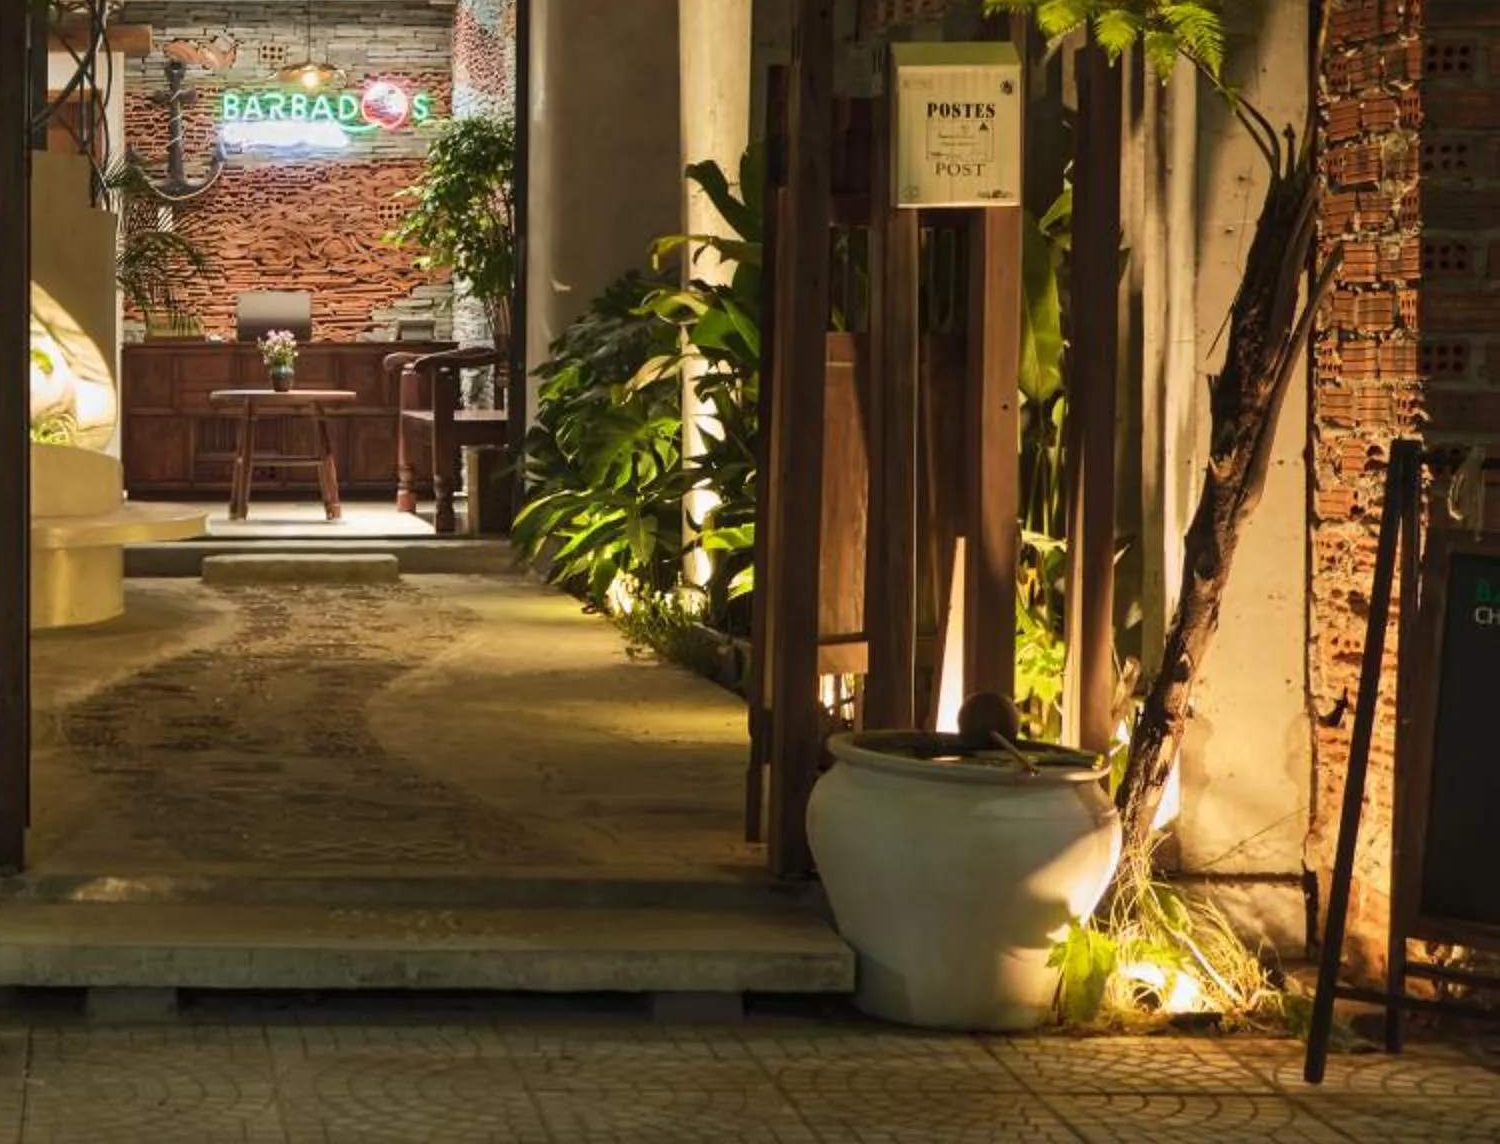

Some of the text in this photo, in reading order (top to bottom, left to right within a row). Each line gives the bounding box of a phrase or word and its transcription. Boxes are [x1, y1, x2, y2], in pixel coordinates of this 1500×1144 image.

[222, 83, 430, 129] BARBADOS
[927, 102, 996, 119] POSTES
[935, 162, 987, 177] POST
